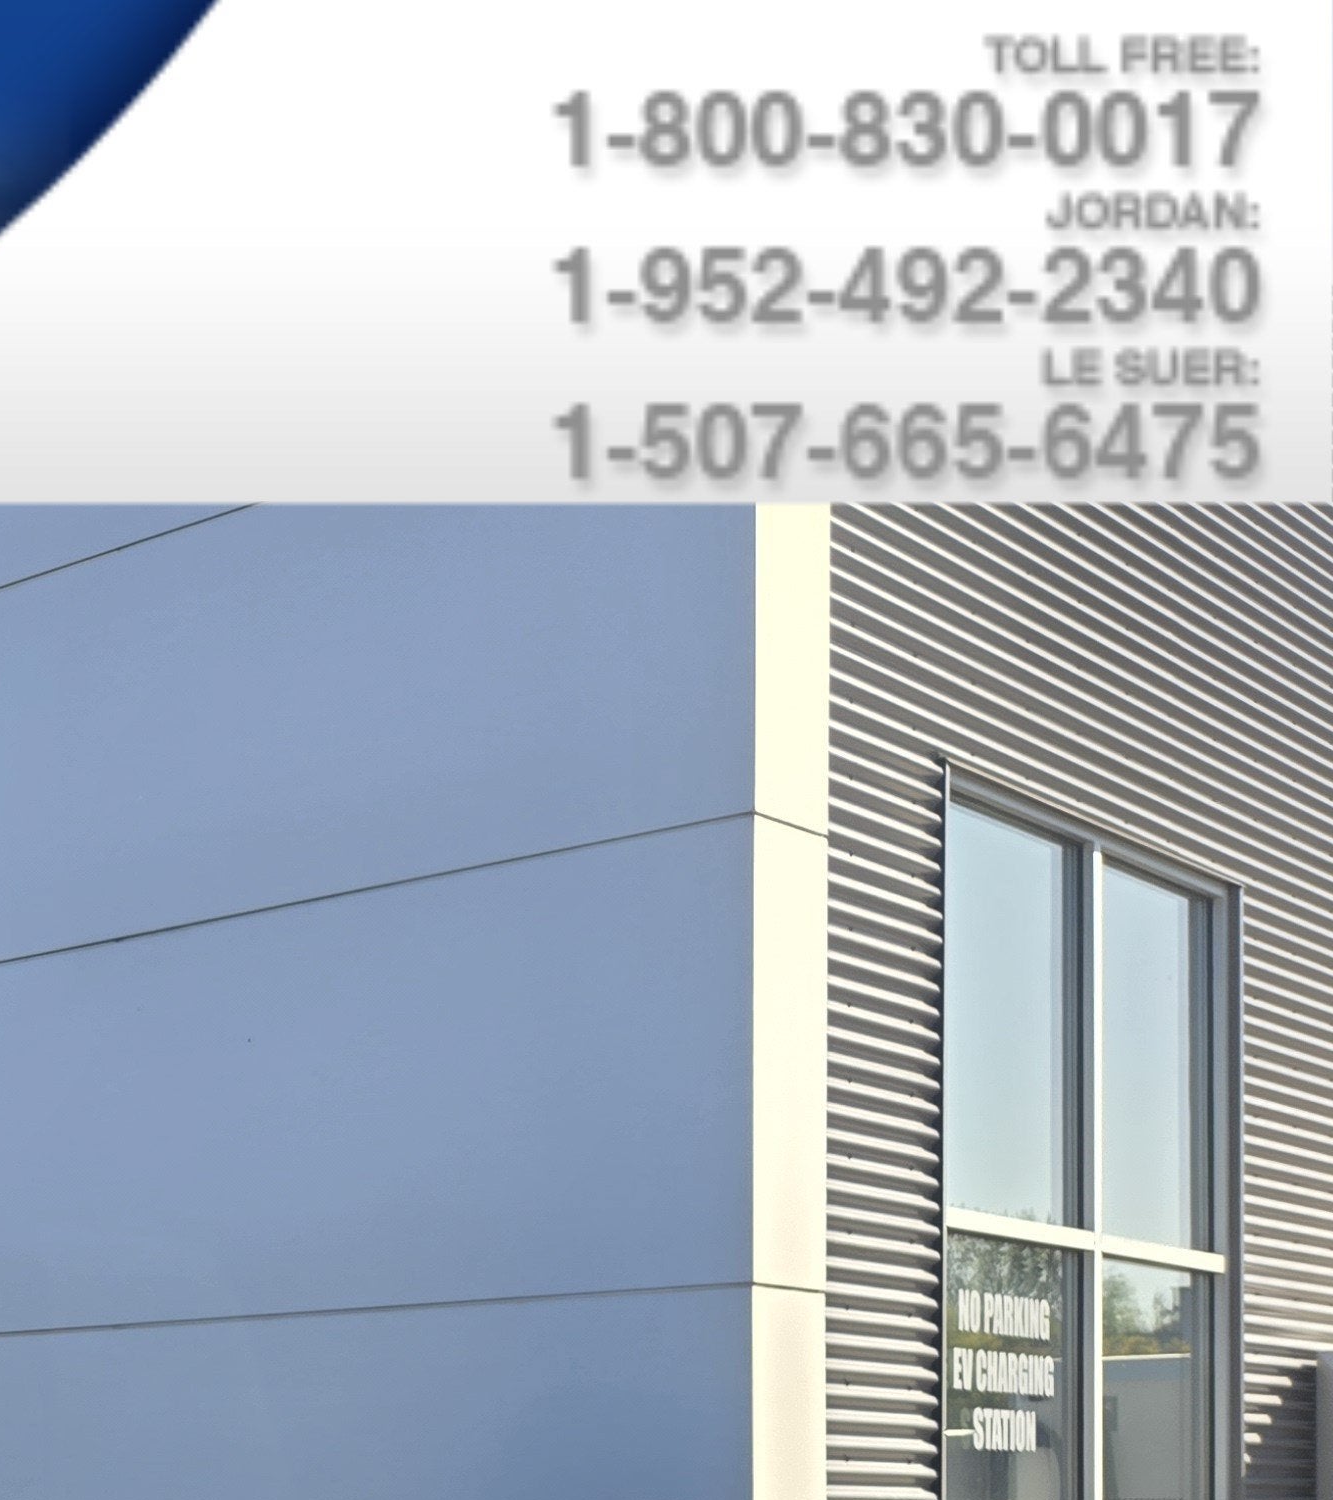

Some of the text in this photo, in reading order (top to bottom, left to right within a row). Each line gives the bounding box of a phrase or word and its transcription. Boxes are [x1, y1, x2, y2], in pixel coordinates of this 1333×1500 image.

[958, 1288, 1050, 1341] NO PARKING
[953, 1347, 1054, 1397] EV CHARGING
[973, 1406, 1036, 1452] STATION
